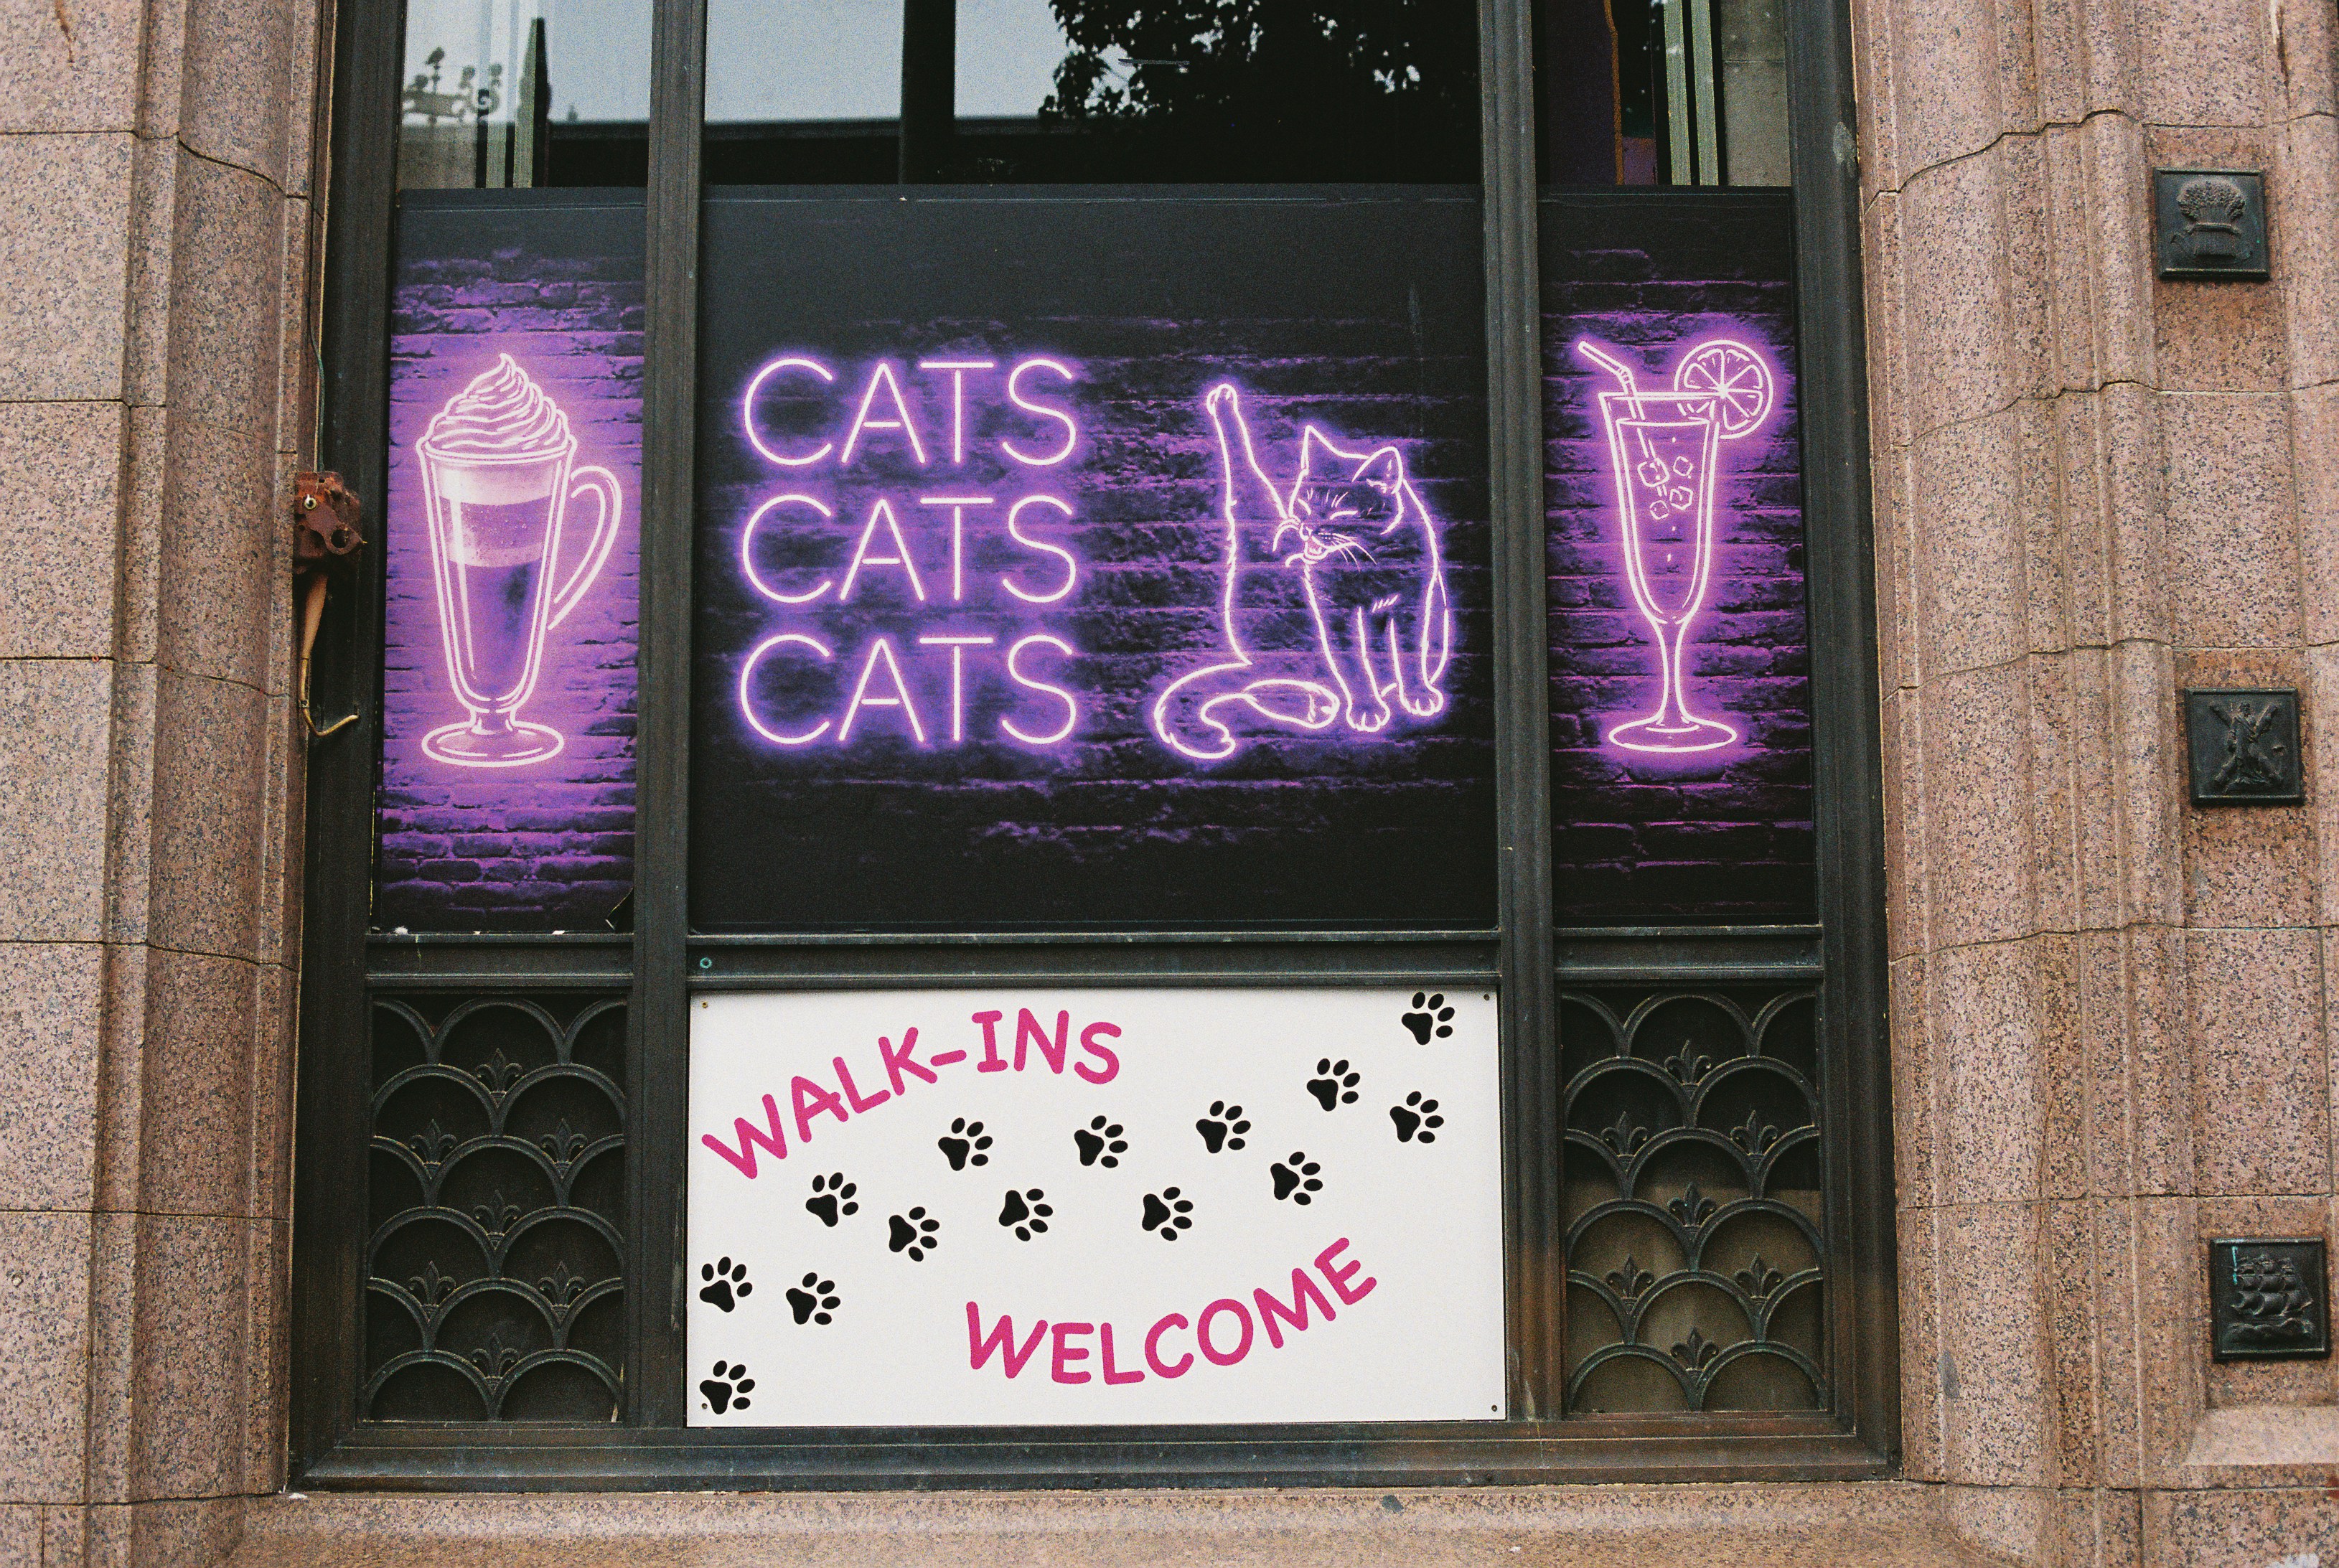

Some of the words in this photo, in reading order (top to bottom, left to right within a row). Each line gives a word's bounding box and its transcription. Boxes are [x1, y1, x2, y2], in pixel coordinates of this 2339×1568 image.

[744, 358, 1077, 466] CATS
[742, 494, 1077, 604] CATS
[740, 634, 1077, 745] CATS
[702, 1008, 1121, 1179] WALK-INS
[966, 1238, 1377, 1385] WELCOME
